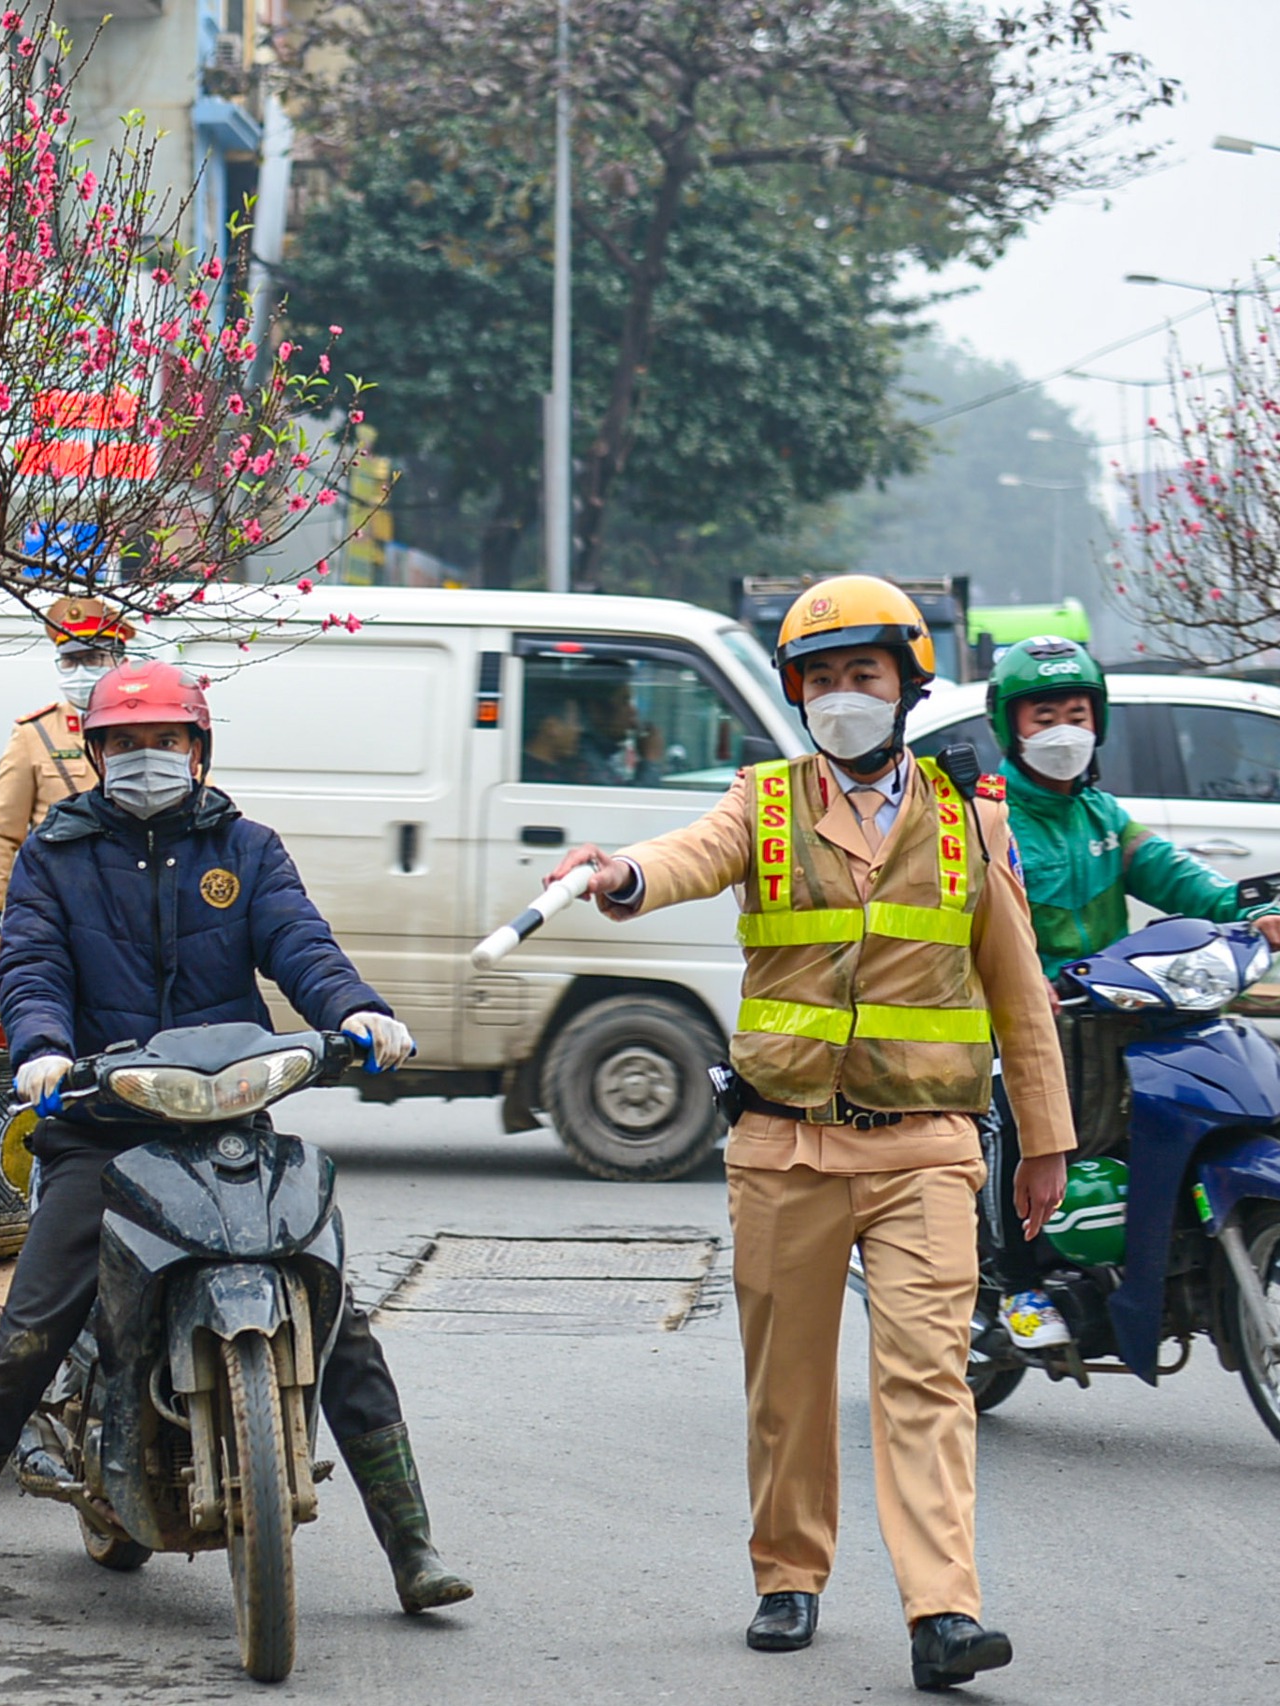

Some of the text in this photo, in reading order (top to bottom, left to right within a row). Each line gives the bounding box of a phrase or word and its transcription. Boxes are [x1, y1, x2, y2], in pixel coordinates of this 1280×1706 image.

[1038, 660, 1082, 677] Grab
[762, 776, 787, 902] CSGT
[931, 774, 962, 897] CSGT
